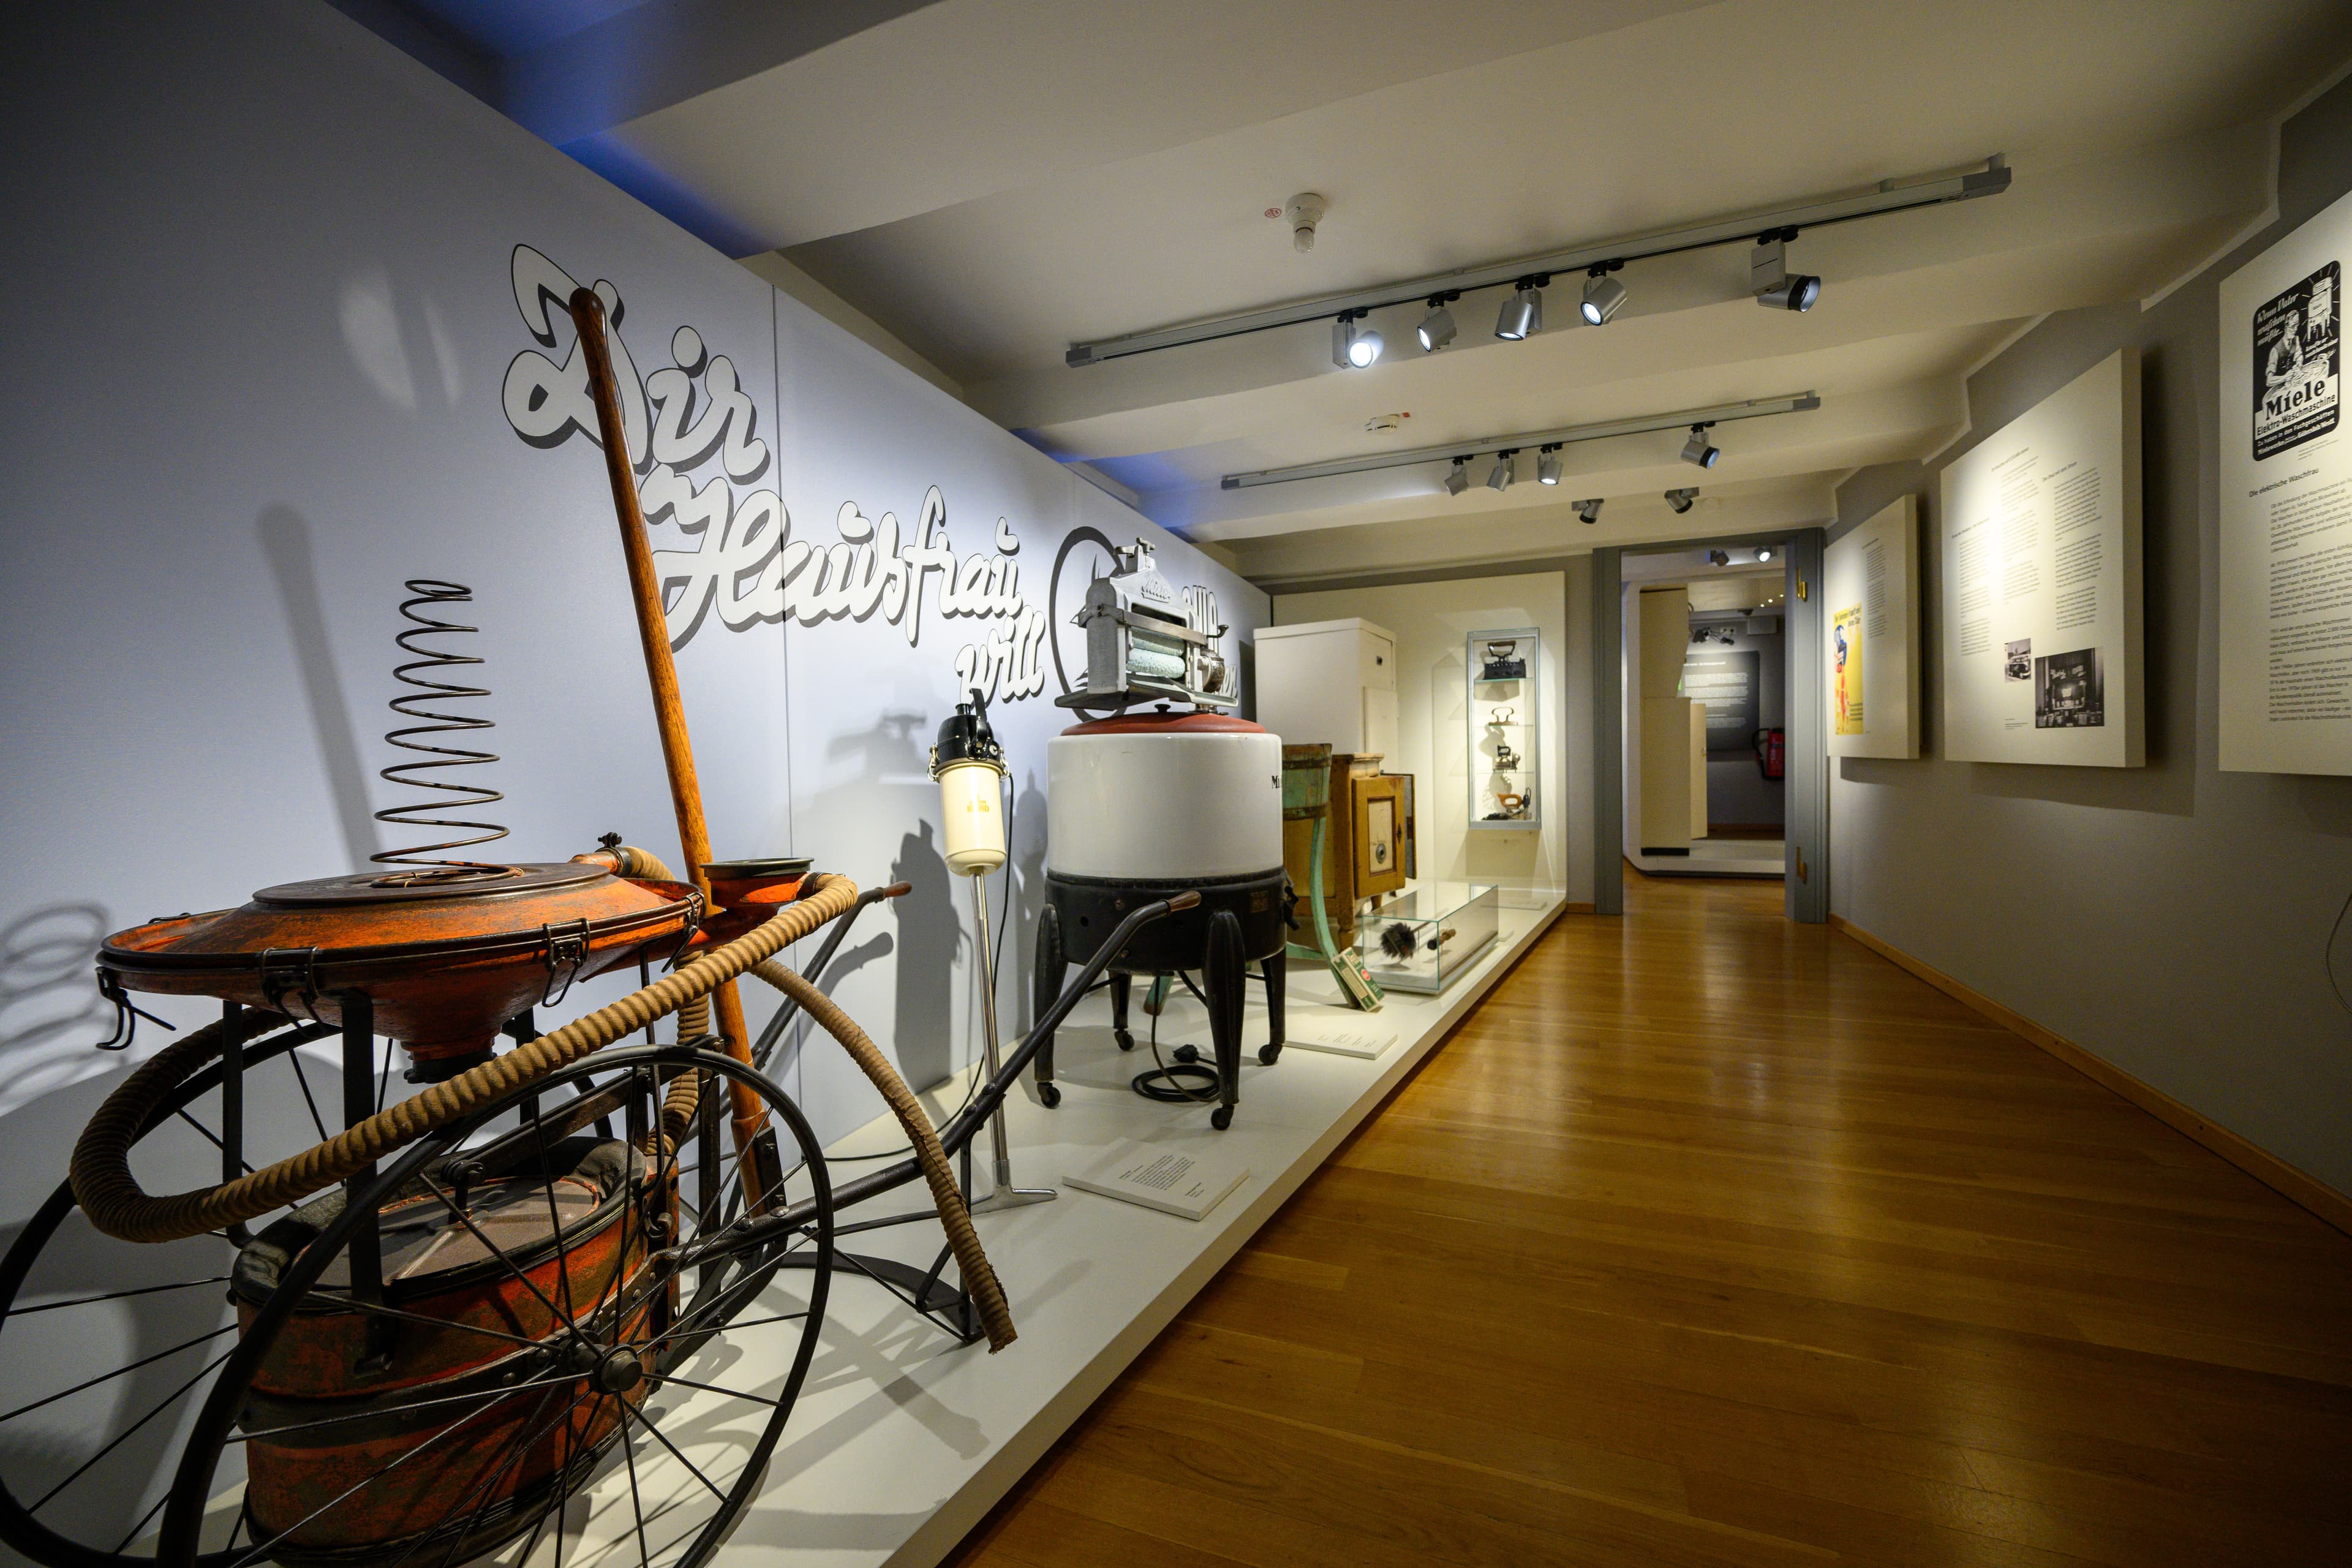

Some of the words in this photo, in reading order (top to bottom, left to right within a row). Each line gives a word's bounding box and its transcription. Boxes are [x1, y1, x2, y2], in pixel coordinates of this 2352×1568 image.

[2257, 394, 2336, 435] Elektro-Waschmaschine
[2266, 380, 2326, 421] Miele
[2260, 480, 2288, 494] elektrische
[2289, 468, 2319, 483] Waschfrau
[955, 604, 1046, 710] will
